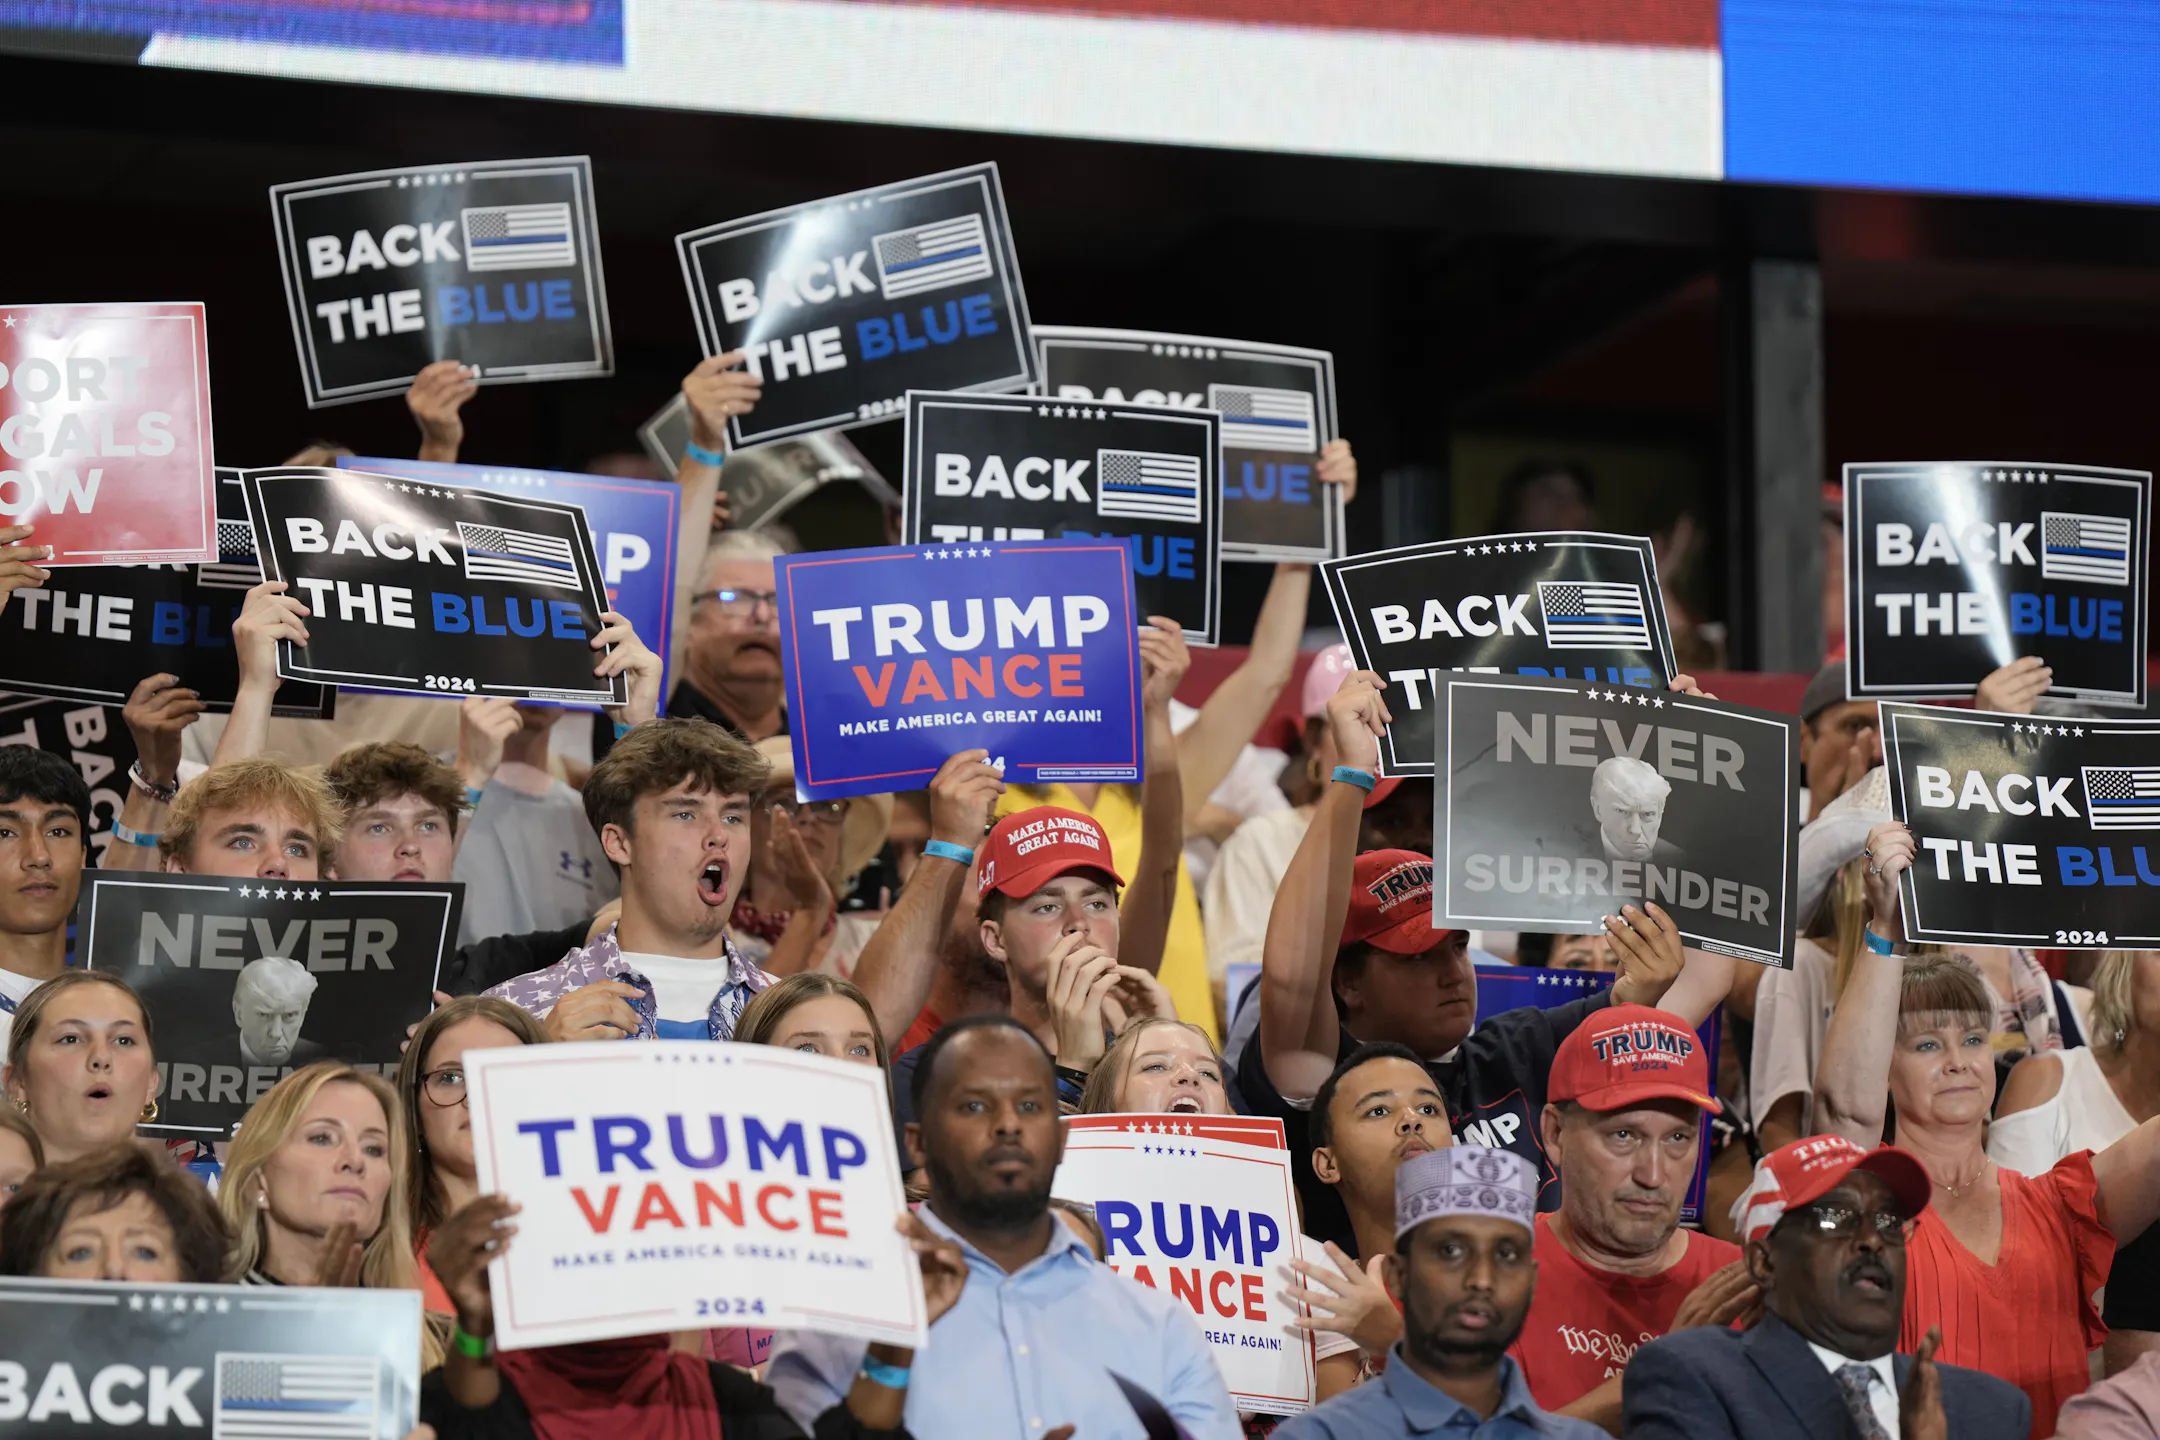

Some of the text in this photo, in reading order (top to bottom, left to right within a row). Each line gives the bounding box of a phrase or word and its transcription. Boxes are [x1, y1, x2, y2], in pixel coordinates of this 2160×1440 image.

[306, 220, 461, 279] BACK
[316, 279, 576, 344] THE BLUE
[718, 251, 876, 324] BACK
[735, 293, 998, 383] THE BLUE
[935, 453, 1091, 503] BACK
[285, 517, 456, 566] BACK
[1875, 522, 2036, 566] BACK
[12, 588, 133, 641] THE
[297, 578, 416, 629] THE
[431, 592, 587, 640] BLUE
[812, 595, 1110, 661] TRUMP
[1370, 593, 1539, 645] BACK
[1875, 592, 2123, 643] THE BLUE
[424, 675, 476, 692] 2024
[852, 654, 1084, 708] VANCE
[839, 710, 1102, 736] MAKE AMERICA GREAT AGAIN!
[1496, 711, 1746, 792] NEVER
[1916, 765, 2081, 818] BACK
[1007, 817, 1100, 845] MAKE AMERICA
[1017, 831, 1100, 856] GREAT AGAIN
[1922, 837, 2042, 885] THE
[1378, 899, 1398, 914] MAKE
[1399, 886, 1427, 902] AMERICA
[1463, 853, 1770, 926] SURRENDER
[138, 911, 398, 971] NEVER
[2055, 930, 2109, 944] 2024
[1592, 1029, 1693, 1062] TRUMP
[1613, 1054, 1638, 1067] SAVE
[1631, 1061, 1669, 1072] 2024
[517, 1114, 867, 1181] TRUMP
[569, 1180, 848, 1239] VANCE
[553, 1251, 615, 1269] MAKE
[625, 1244, 724, 1262] AMERICA
[734, 1244, 797, 1261] GREAT
[696, 1298, 766, 1315] 2024
[1241, 1334, 1282, 1351] AGAIN!
[1557, 1325, 1608, 1360] We
[0, 1361, 204, 1428] BACK
